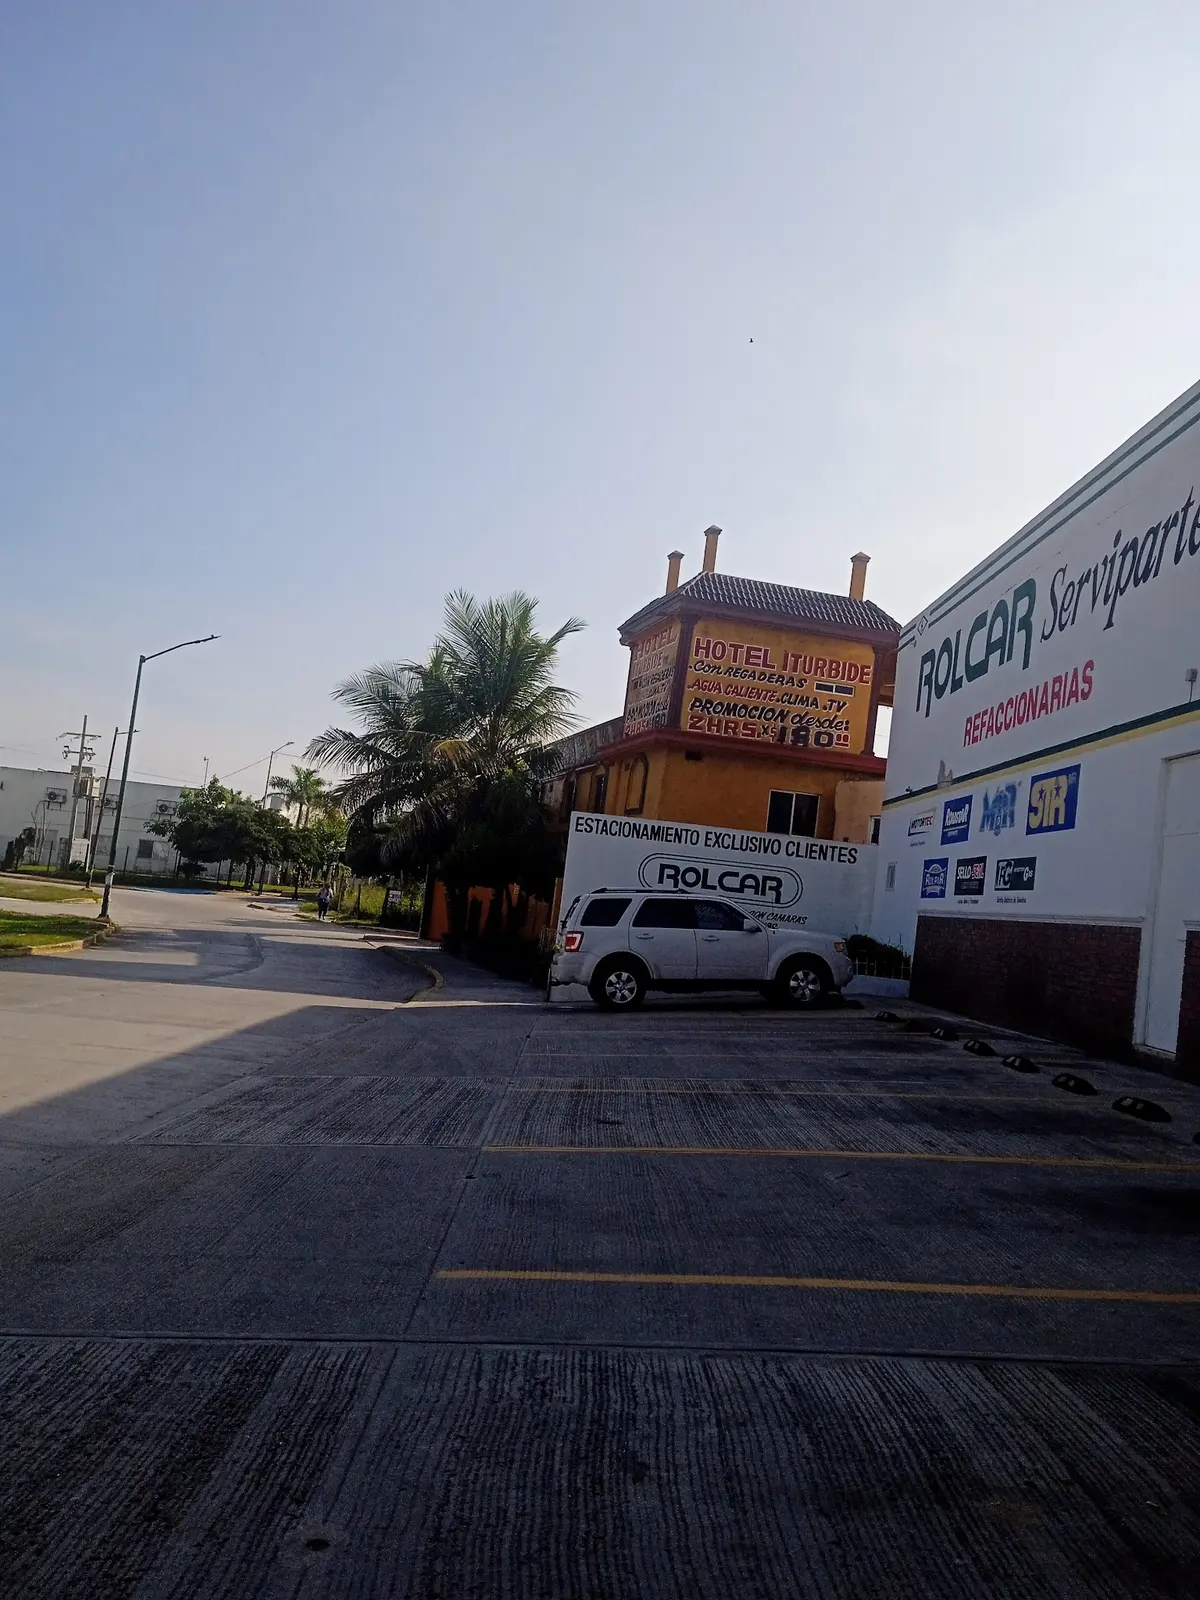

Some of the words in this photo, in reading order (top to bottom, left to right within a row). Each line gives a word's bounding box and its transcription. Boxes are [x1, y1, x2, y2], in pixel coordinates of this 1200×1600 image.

[693, 637, 776, 671] HOTEL
[782, 650, 872, 685] ITURBIDE
[916, 577, 1036, 718] ROLCAR
[722, 665, 808, 689] REGADERAS
[688, 697, 790, 724] PROMOCION
[963, 659, 1095, 748] REFACCIONARIAS
[575, 816, 700, 846] ESTACIONAMIENTO
[704, 831, 782, 856] EXCLUSIVO
[785, 840, 858, 864] CLIENTES
[657, 862, 783, 904] ROLCAR
[766, 912, 808, 925] CAMARAS
